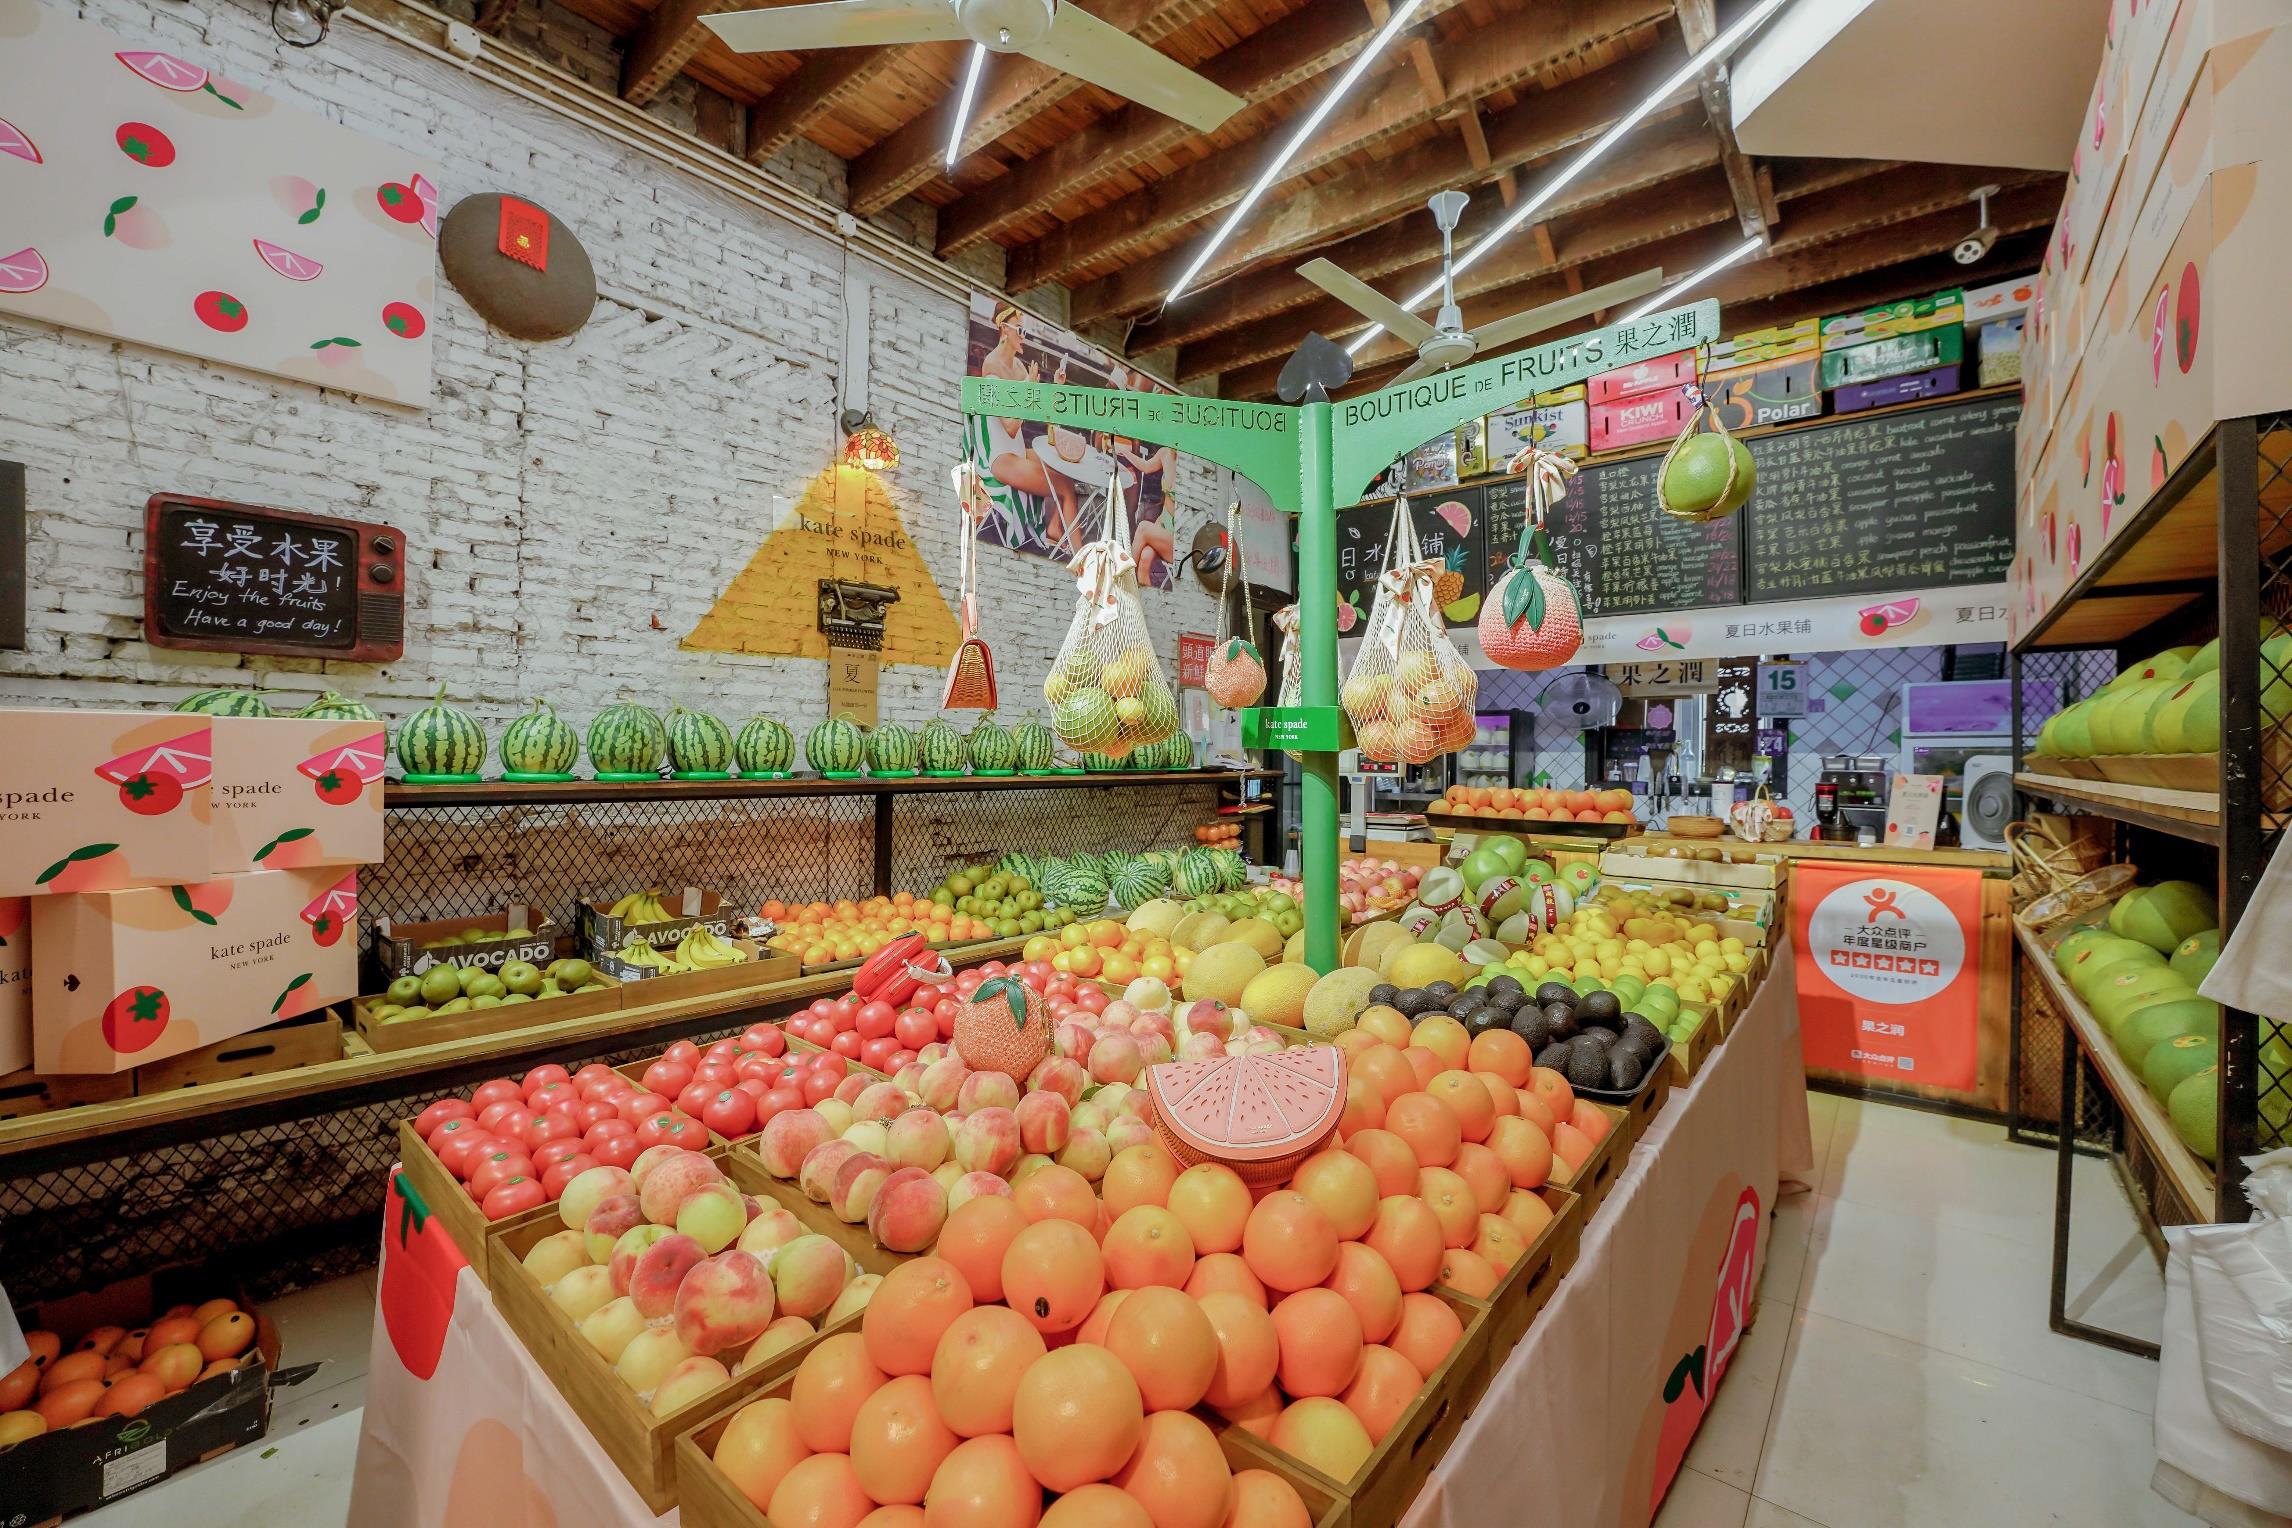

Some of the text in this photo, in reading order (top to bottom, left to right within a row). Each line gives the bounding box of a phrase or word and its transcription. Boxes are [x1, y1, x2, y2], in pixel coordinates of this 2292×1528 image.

[1345, 374, 1467, 428] BOUTIQUE
[1475, 376, 1493, 394] DE
[1501, 338, 1604, 388] FRUITS
[1504, 408, 1564, 432] Sunkist
[1620, 401, 1664, 420] KIWI
[1620, 414, 1664, 428] CRUNCH
[1757, 403, 1810, 424] Polar
[1892, 461, 1932, 476] avocado
[1933, 472, 1975, 486] avocado
[800, 512, 906, 551] kate spade
[1922, 524, 1959, 538] mango
[179, 518, 344, 572] 享受水果
[1341, 532, 1445, 568] 日水铺
[826, 547, 884, 565] NEW YORK
[171, 580, 327, 612] Enjoy the fruits
[183, 608, 342, 638] Have a good day!
[1724, 618, 1812, 640] 夏日水果铺
[1587, 631, 1617, 644] spade
[844, 663, 861, 684] 夏
[1618, 660, 1703, 688] 果之潤
[1767, 670, 1797, 691] 15
[1265, 718, 1308, 732] kate spade
[222, 781, 283, 799] spade
[647, 922, 728, 946] AVOCDO
[1857, 925, 1911, 940] 大众点评
[210, 932, 291, 960] kate spade
[1843, 935, 1928, 953] 年度星级商户
[230, 955, 275, 971] NEW YORK
[448, 945, 550, 971] AVOCADO
[0, 967, 32, 985] kat
